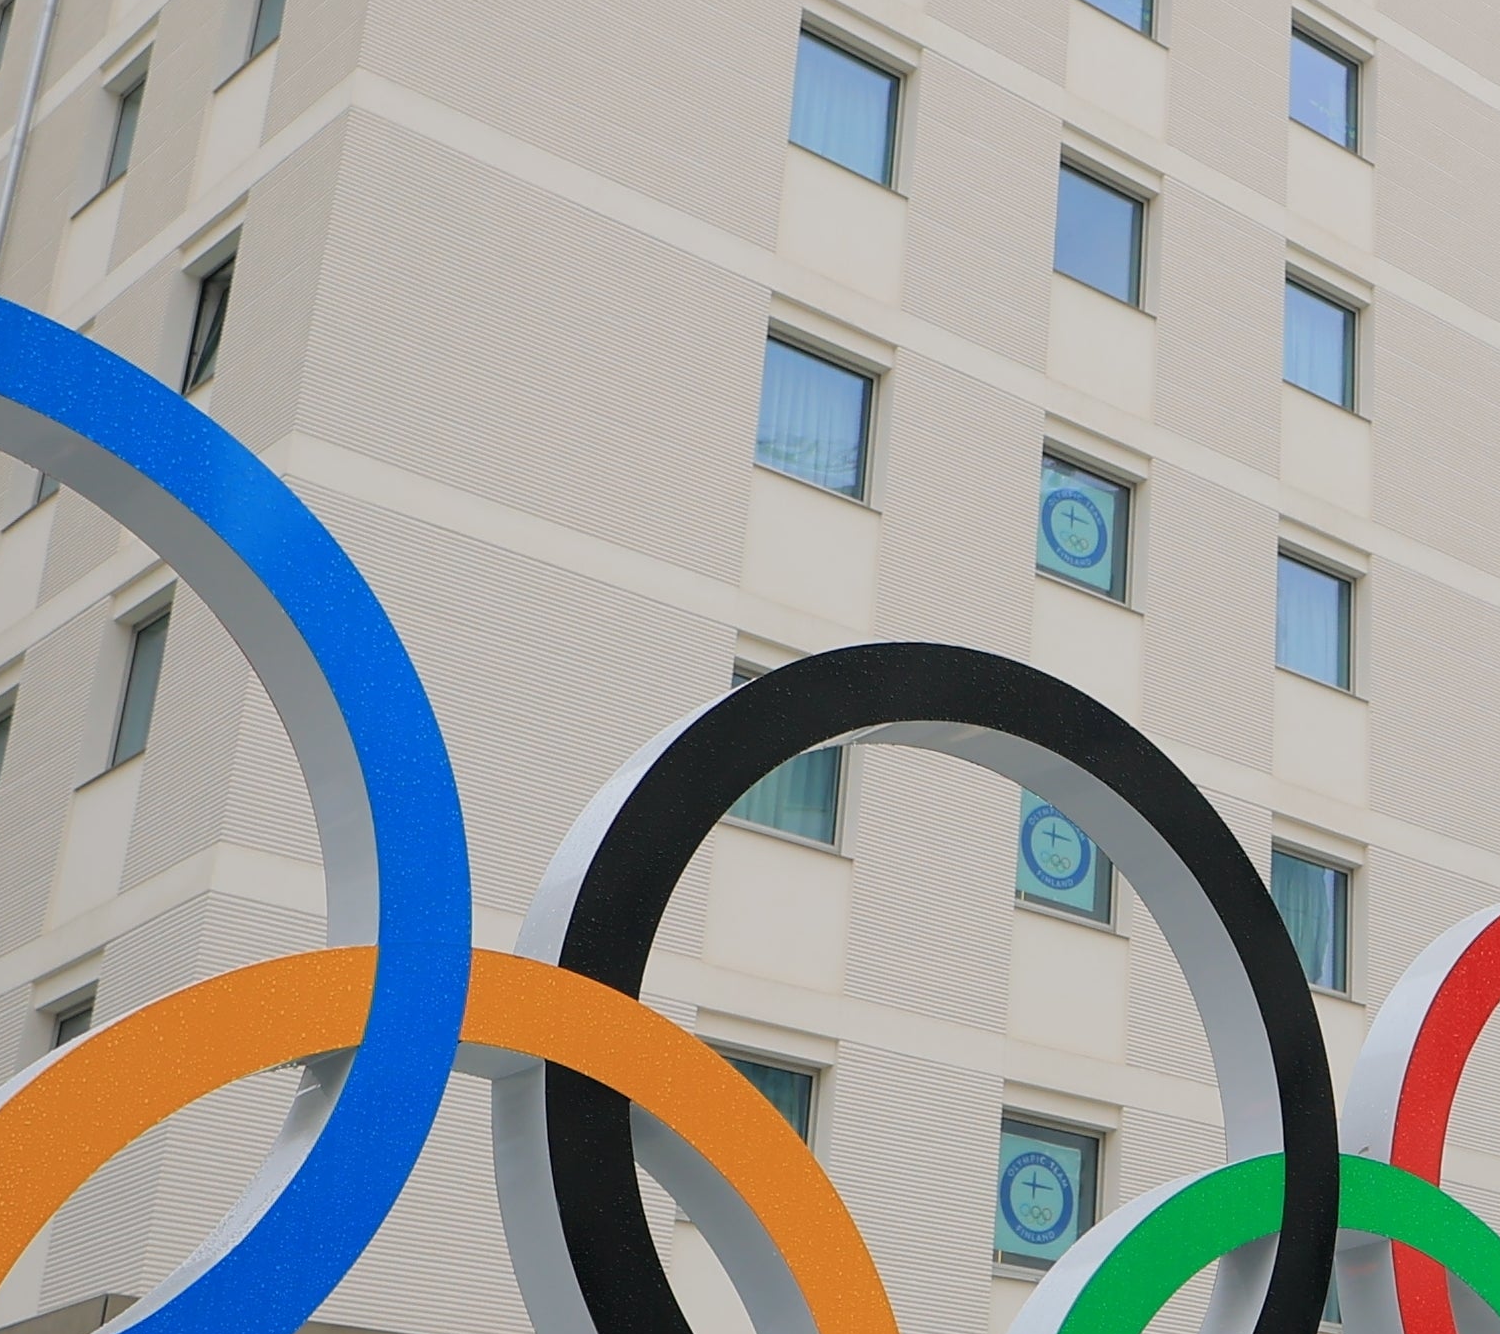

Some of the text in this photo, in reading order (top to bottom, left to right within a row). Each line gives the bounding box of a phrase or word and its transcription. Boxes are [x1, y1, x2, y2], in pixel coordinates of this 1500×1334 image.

[1036, 869, 1074, 888] FINLAND
[1007, 1153, 1069, 1189] OLYMPIC TEAM
[1016, 1225, 1056, 1242] FINLAND
